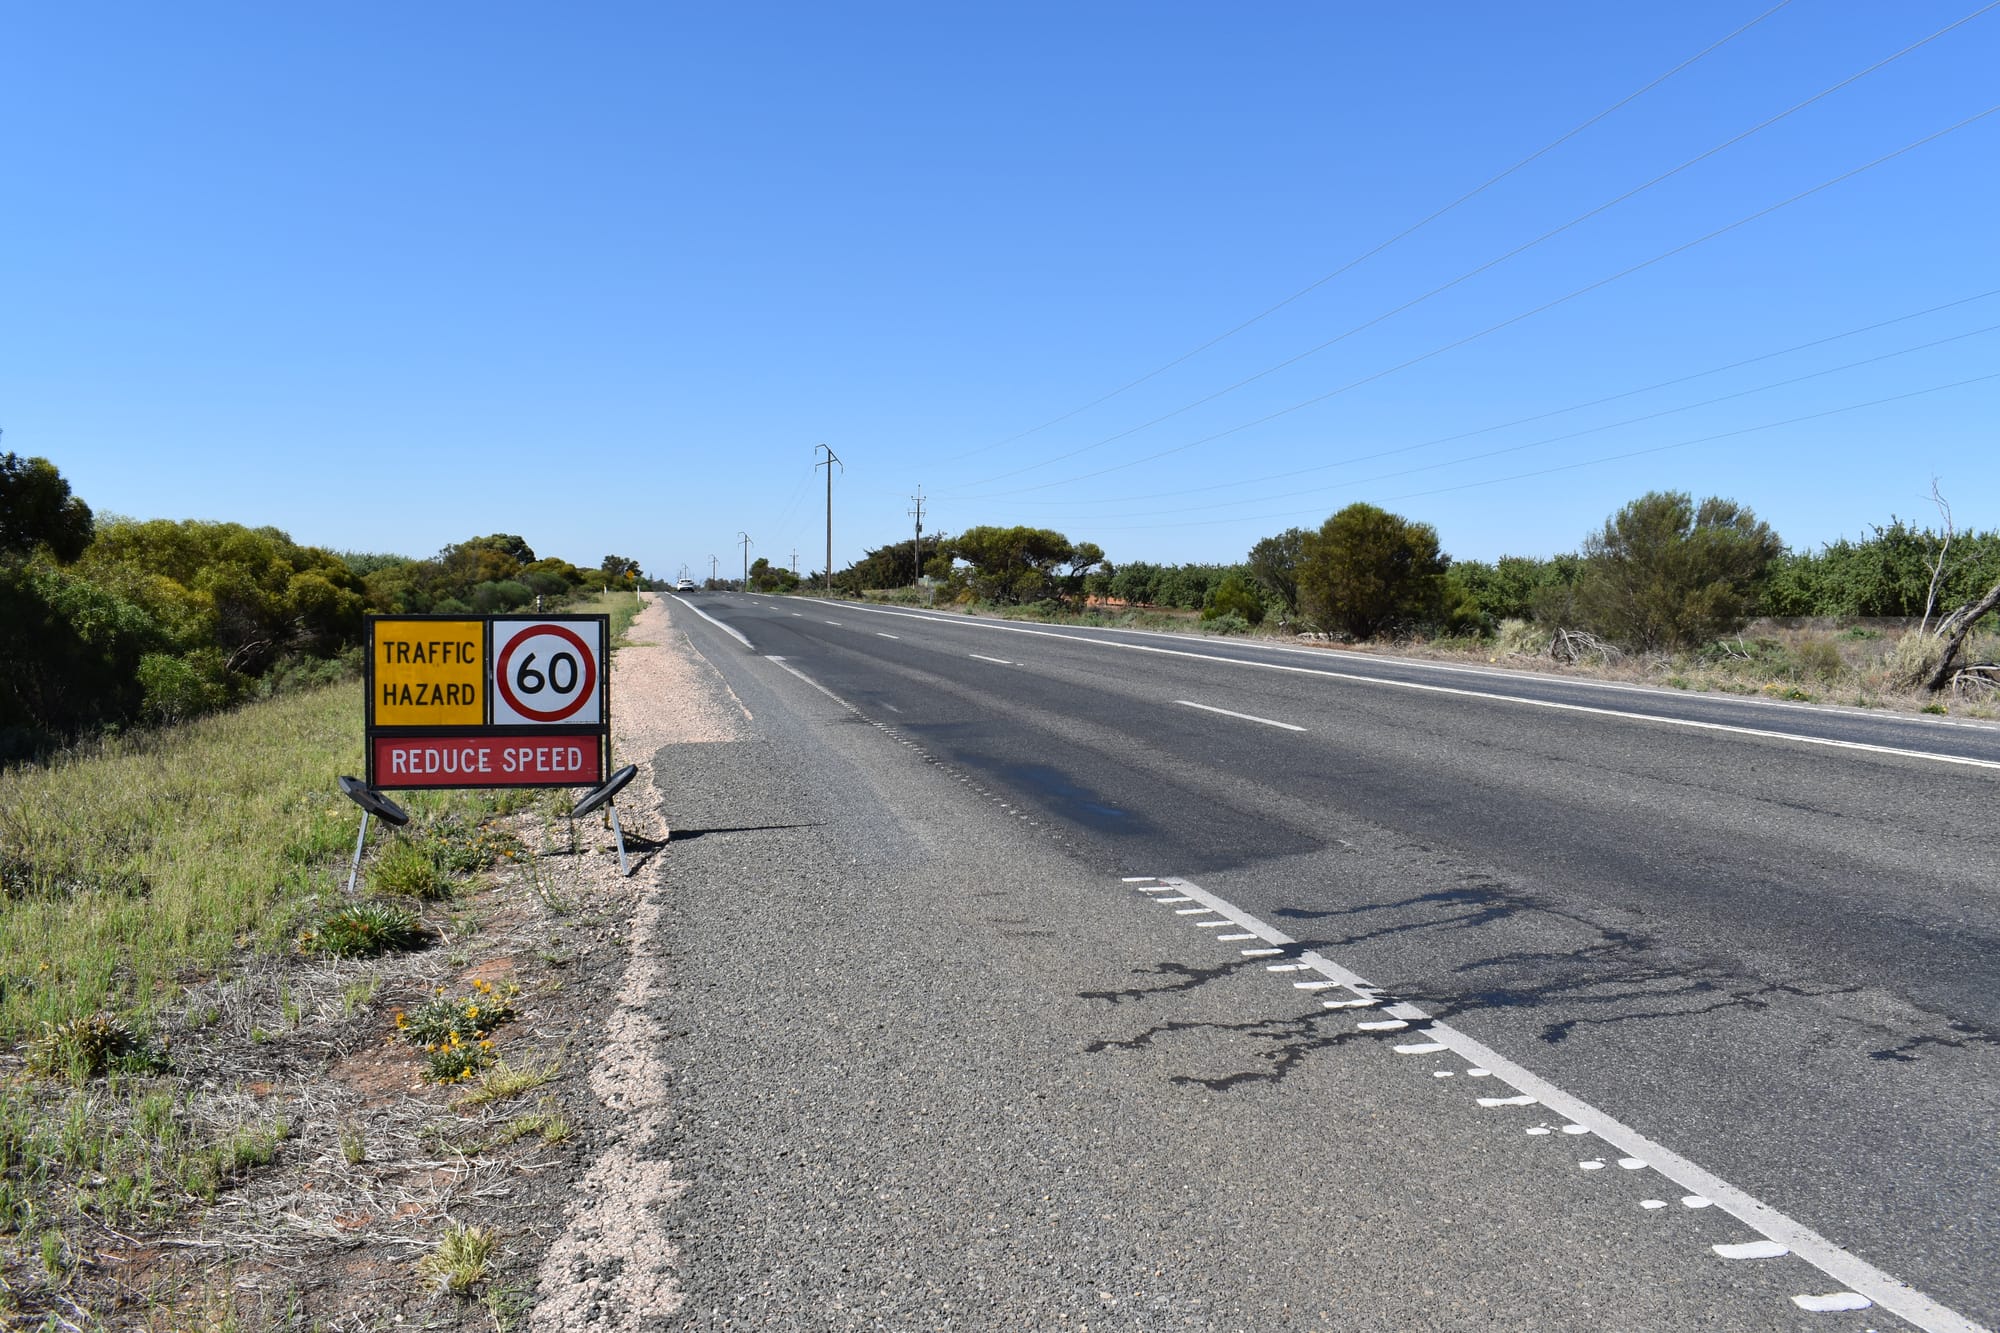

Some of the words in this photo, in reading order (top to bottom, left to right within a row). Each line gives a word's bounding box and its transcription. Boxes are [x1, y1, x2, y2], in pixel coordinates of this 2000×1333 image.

[383, 641, 476, 665] TRAFFIC
[516, 651, 578, 695] 60
[383, 683, 476, 706] HAZARD
[392, 748, 492, 774] REDUCE
[502, 747, 583, 772] SPEED
